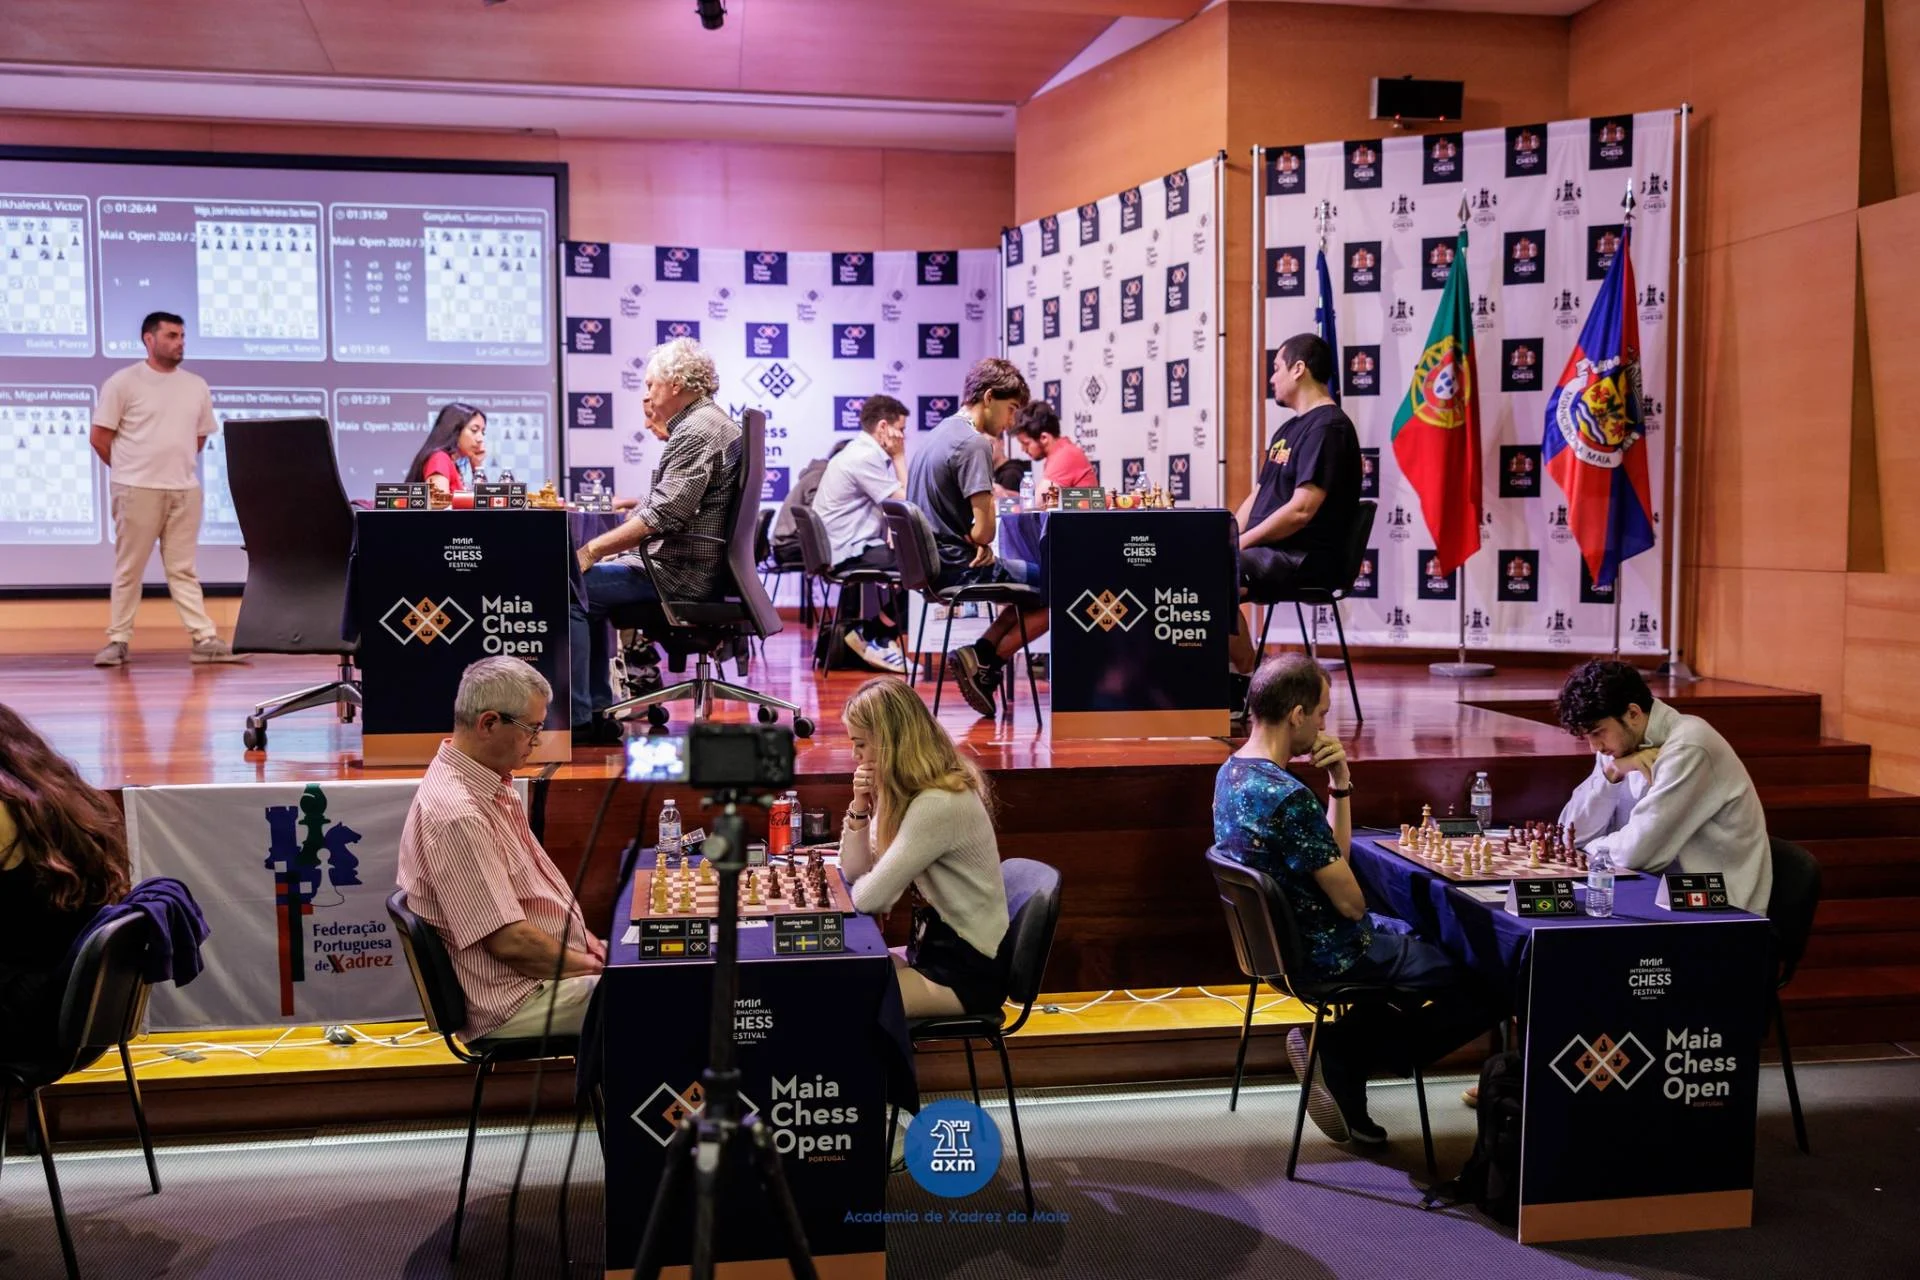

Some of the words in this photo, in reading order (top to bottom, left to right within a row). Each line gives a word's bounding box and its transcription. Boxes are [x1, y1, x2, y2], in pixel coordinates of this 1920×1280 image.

[128, 231, 156, 243] Open
[359, 236, 385, 248] Open
[363, 421, 390, 434] Open
[1586, 452, 1611, 464] MAIA
[444, 551, 482, 561] CHESS
[1123, 548, 1156, 556] CHESS
[1155, 587, 1198, 604] Maia
[482, 595, 533, 614] Maia
[1155, 605, 1211, 622] Chess
[482, 614, 548, 633] Chess
[1155, 623, 1206, 644] Open
[482, 635, 543, 656] Open
[313, 921, 386, 938] Federação
[314, 938, 392, 954] Portuguesa
[315, 960, 329, 971] de
[328, 953, 393, 973] Xadrez
[1628, 974, 1672, 987] CHESS
[1633, 988, 1665, 996] FESTIVAL
[733, 1016, 774, 1030] HESS
[1666, 1027, 1722, 1050] Maia
[1664, 1051, 1737, 1075] Chess
[771, 1075, 839, 1100] Maia
[1663, 1077, 1729, 1104] Open
[771, 1100, 858, 1126] Chess
[772, 1129, 851, 1159] Open
